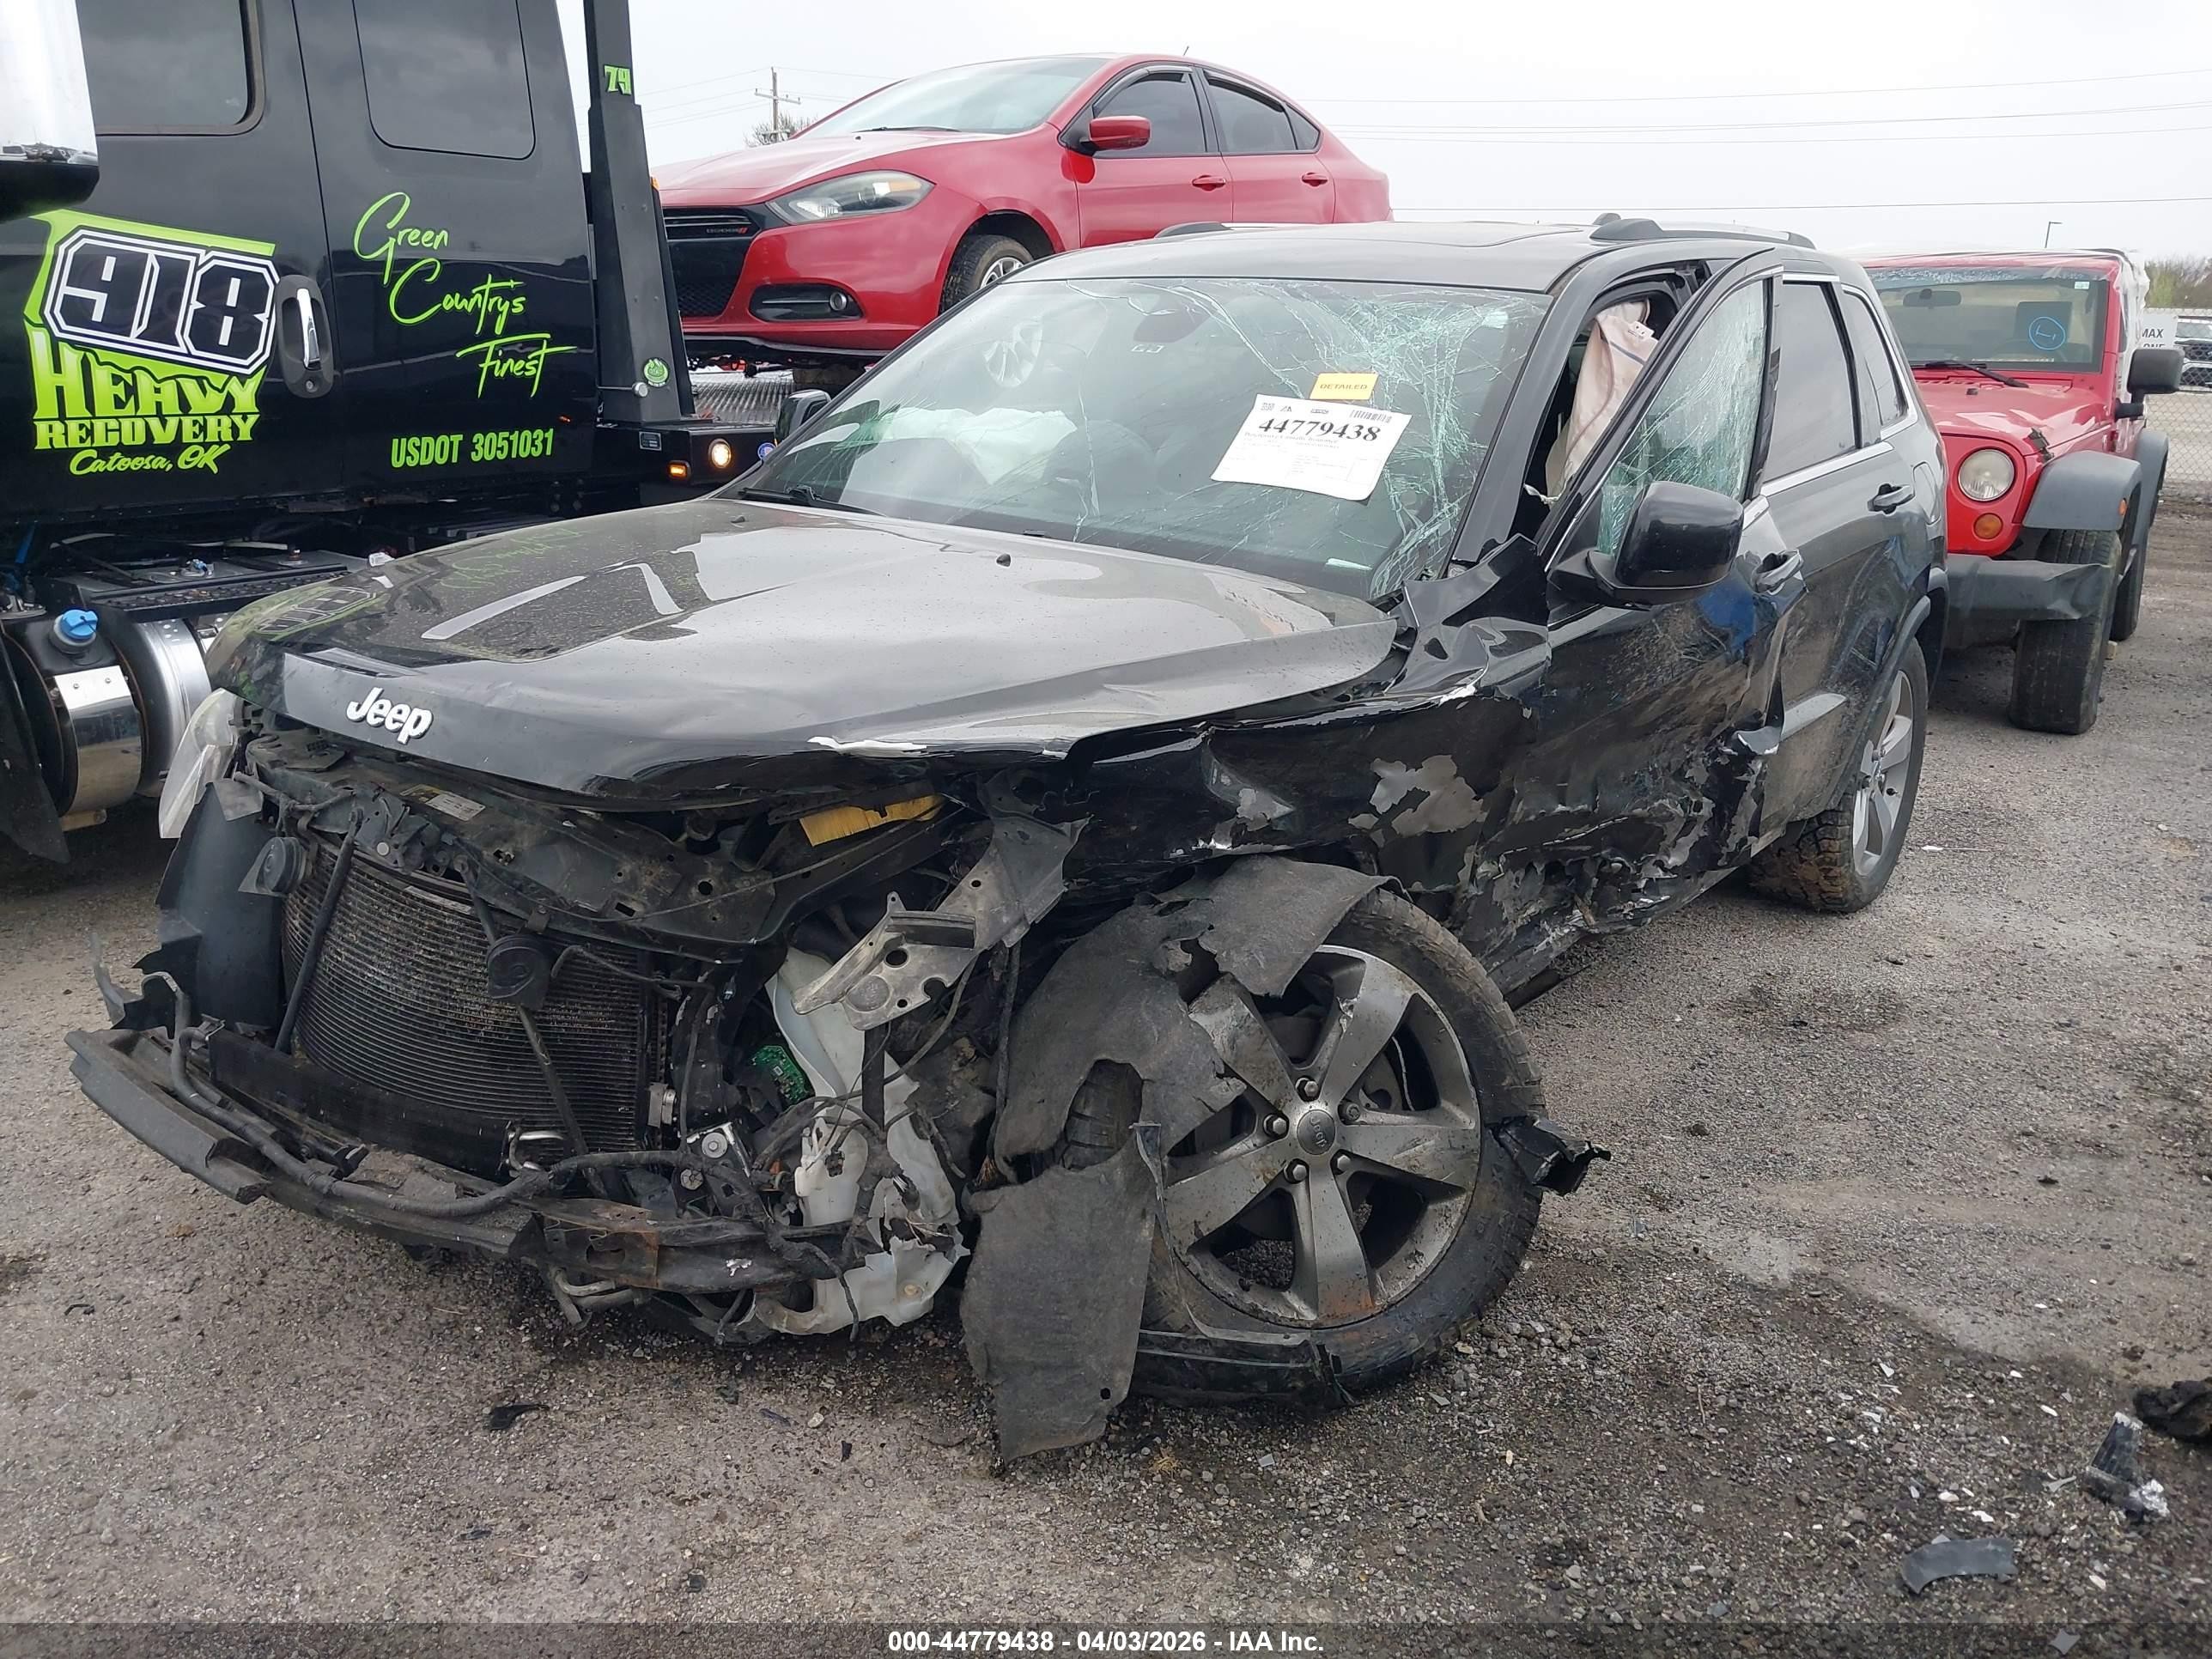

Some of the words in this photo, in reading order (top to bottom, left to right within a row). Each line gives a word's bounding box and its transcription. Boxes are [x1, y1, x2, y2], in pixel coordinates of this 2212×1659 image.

[354, 191, 448, 285] Green
[44, 228, 280, 374] 918
[389, 258, 526, 335] Countrys
[24, 319, 267, 419] HEAVY
[455, 333, 578, 398] Finest
[33, 414, 260, 450] RECOVERY
[70, 449, 173, 475] Catoosa,
[178, 444, 231, 474] OK
[392, 434, 463, 467] USDOT
[471, 428, 554, 461] 3051031
[1258, 418, 1381, 441] 44779438
[346, 687, 434, 744] Jeep
